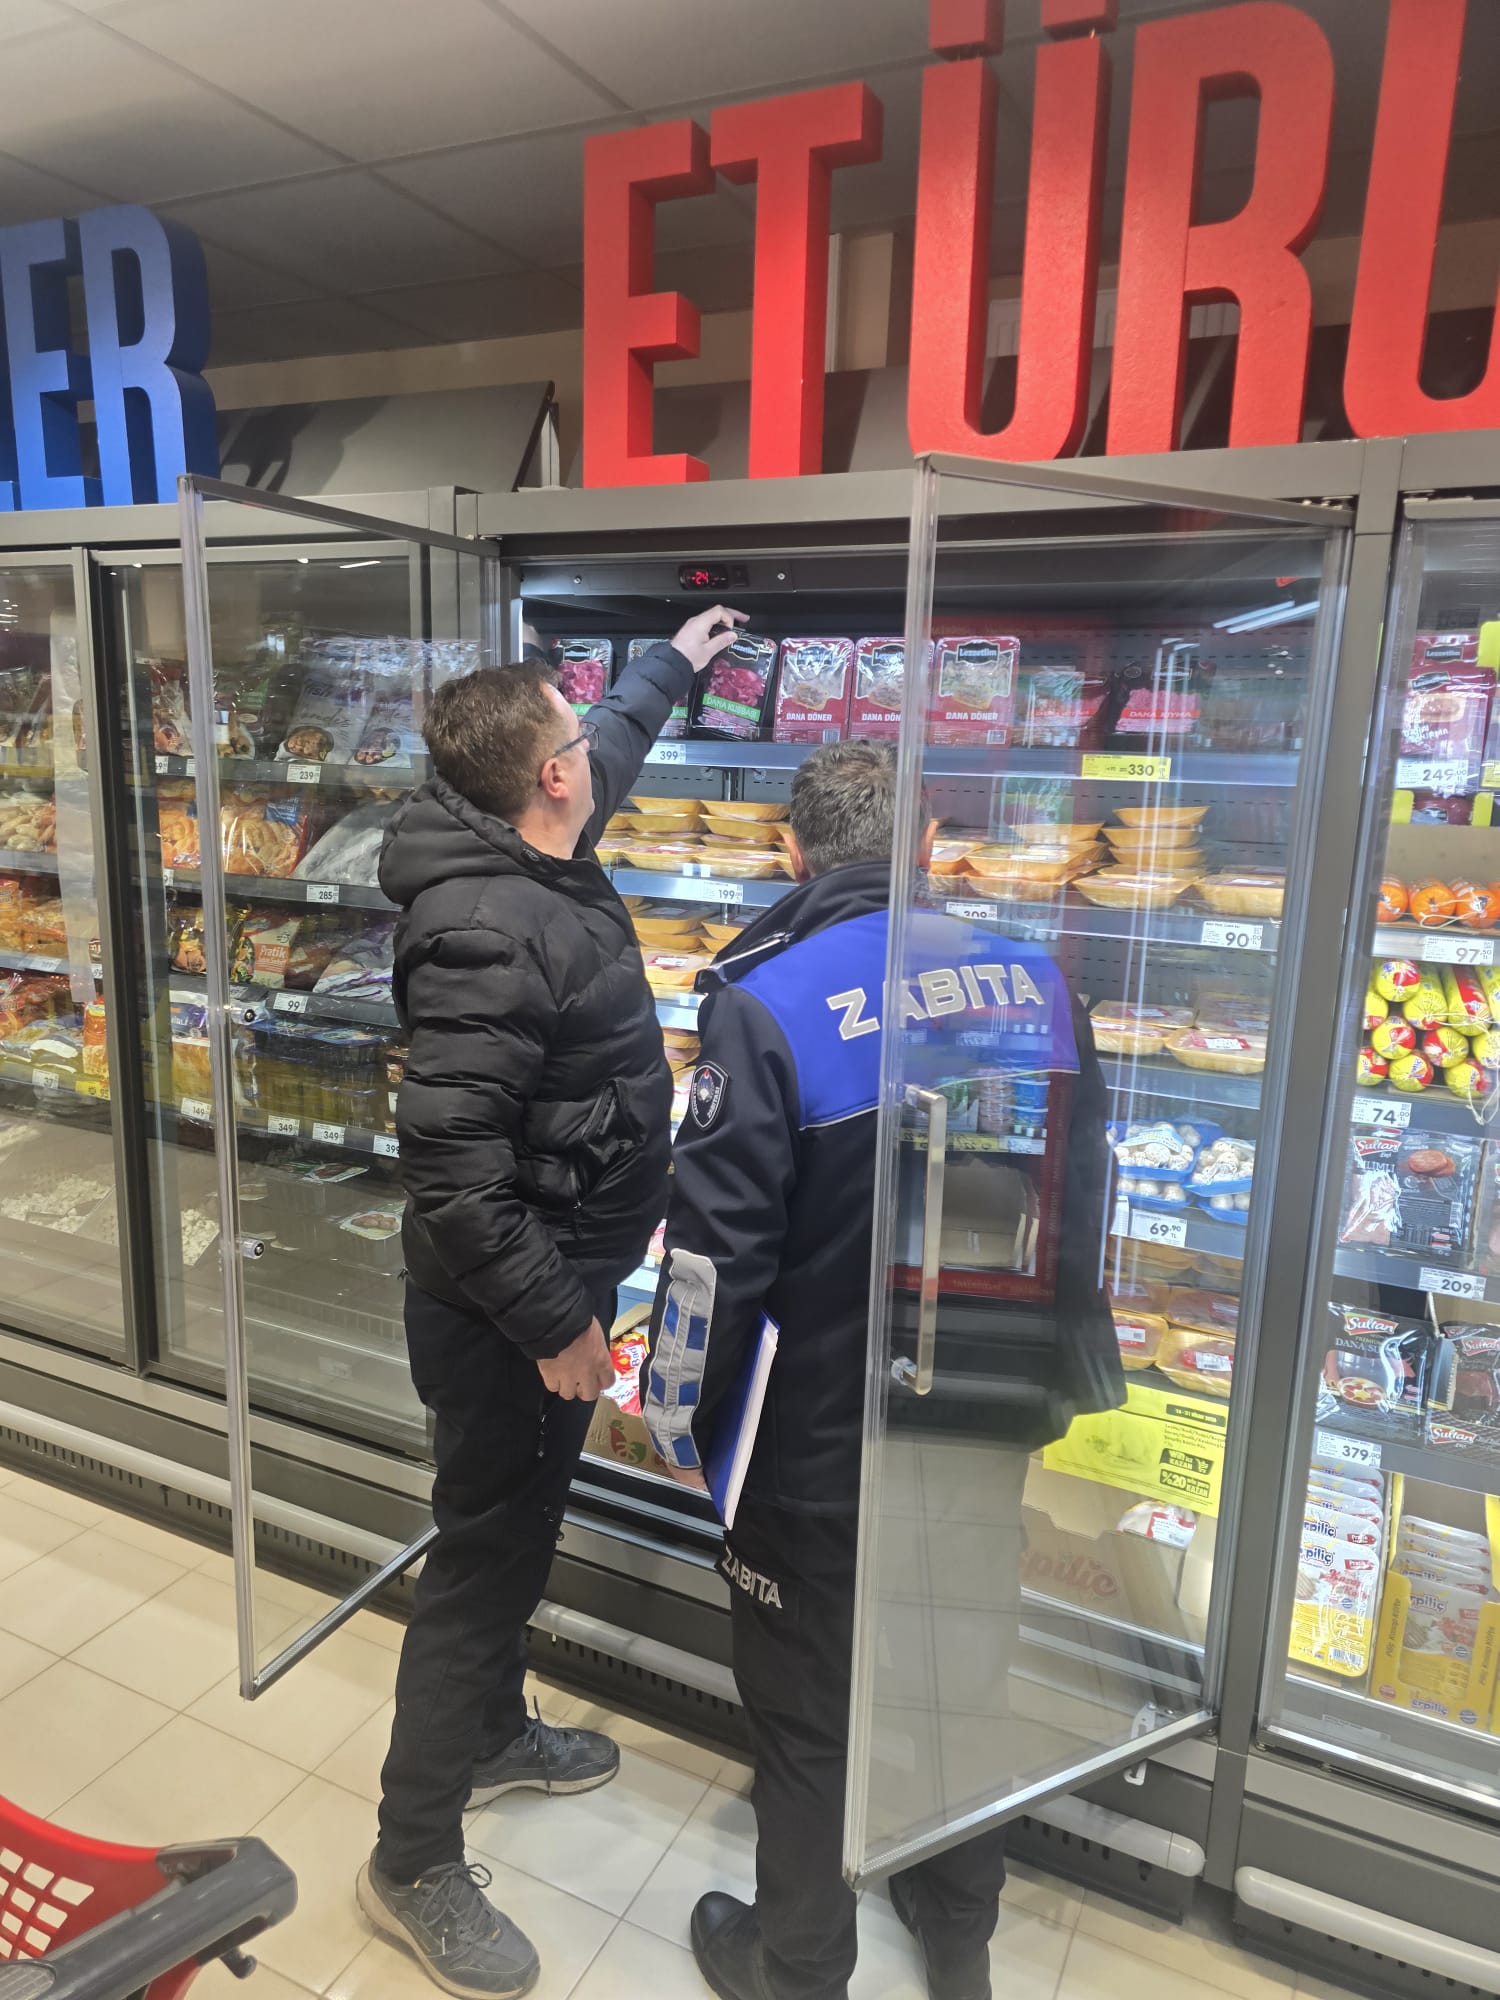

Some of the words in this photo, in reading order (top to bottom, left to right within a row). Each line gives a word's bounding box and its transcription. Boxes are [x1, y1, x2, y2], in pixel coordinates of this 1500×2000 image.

[584, 82, 882, 489] ET
[0, 204, 205, 508] ER
[786, 712, 806, 721] DANA
[807, 711, 832, 721] DÖNER
[862, 712, 882, 721] DANA
[884, 711, 902, 721] DÖN
[945, 711, 968, 721] DANA
[970, 710, 998, 721] DÖNER
[660, 750, 679, 761] 399
[299, 771, 314, 780] 239
[1128, 763, 1155, 777] 330
[319, 891, 333, 900] 285
[718, 889, 735, 900] 199
[260, 945, 287, 959] Pratik
[288, 1000, 301, 1011] 99
[278, 1122, 293, 1133] 349
[323, 1130, 339, 1140] 349
[1346, 1316, 1395, 1333] Sultan
[1335, 1337, 1365, 1351] DANA
[1432, 1427, 1475, 1443] Sultan
[1161, 1469, 1187, 1490] %20
[1300, 1546, 1334, 1565] piliç
[721, 1543, 783, 1609] ZABITA
